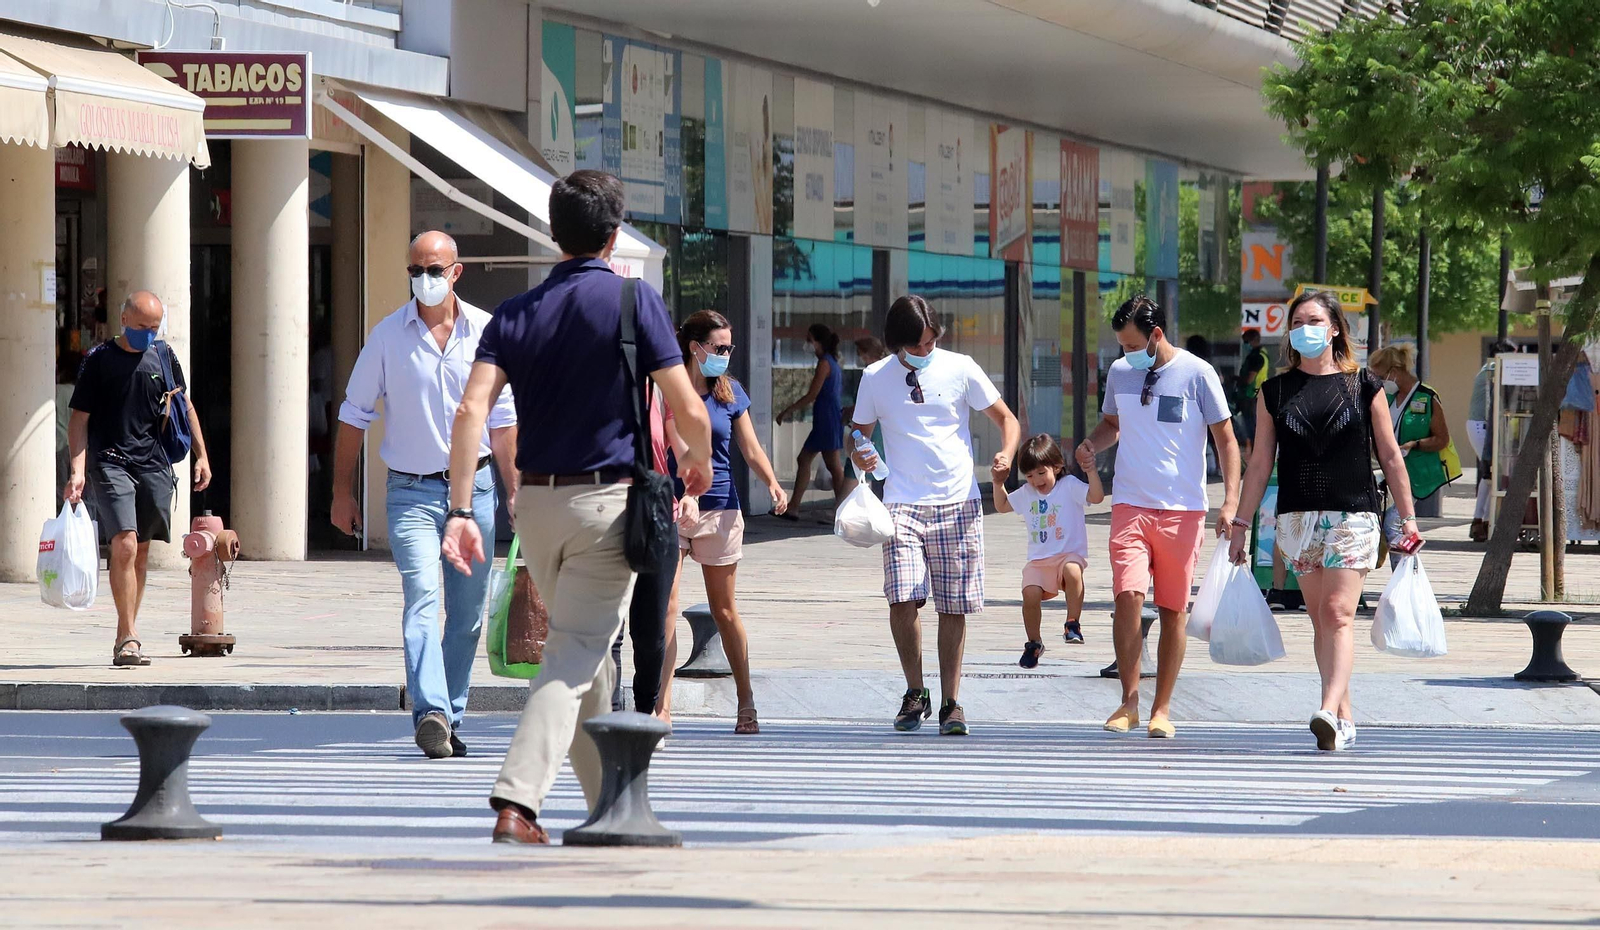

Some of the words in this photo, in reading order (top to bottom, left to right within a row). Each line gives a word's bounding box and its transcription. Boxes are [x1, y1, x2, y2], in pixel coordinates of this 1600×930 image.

[183, 62, 302, 93] TABACOS
[275, 96, 284, 105] 19
[80, 103, 126, 140] GOLOSINAS
[128, 106, 156, 144] MARÍA
[157, 114, 181, 148] LUISA
